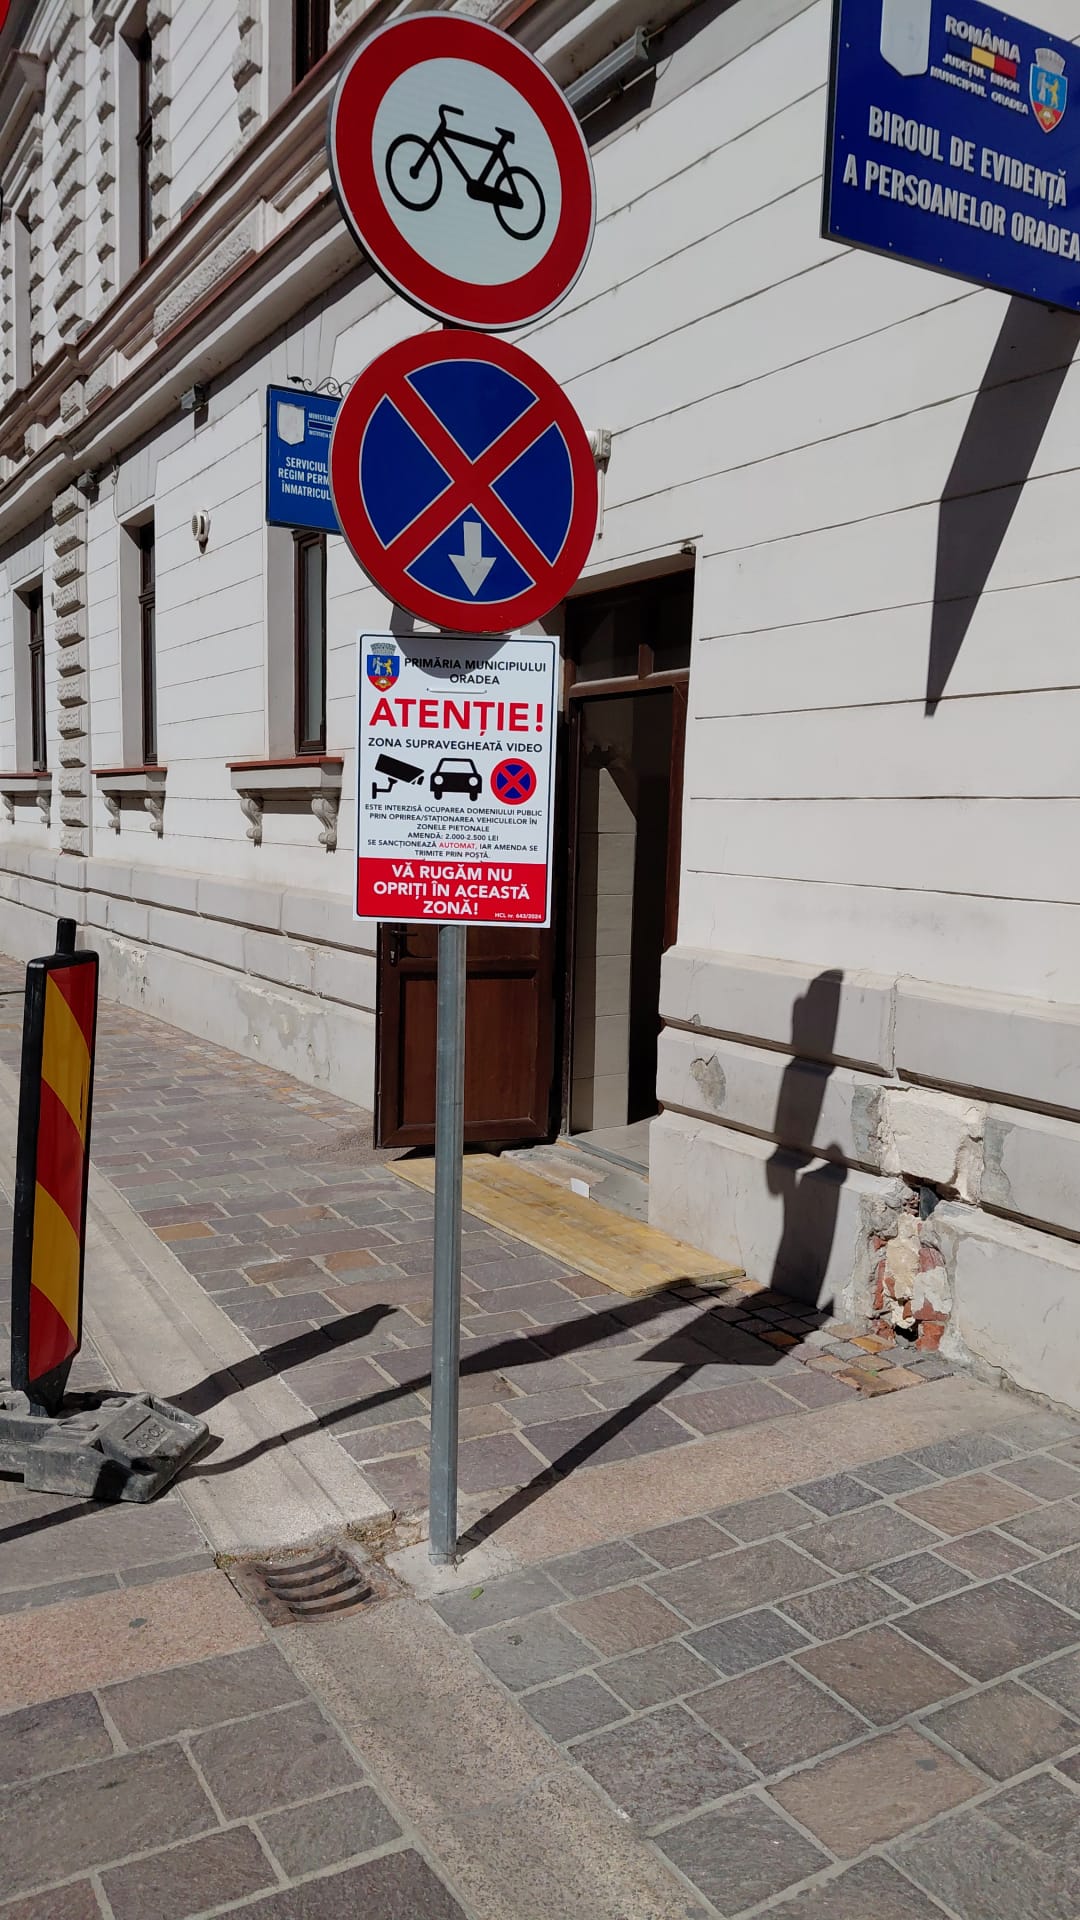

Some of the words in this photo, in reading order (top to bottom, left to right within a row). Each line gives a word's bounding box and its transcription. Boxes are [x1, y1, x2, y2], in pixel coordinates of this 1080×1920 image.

[945, 14, 1020, 63] ROMÂNIA
[942, 53, 986, 79] JUDEȚUL
[990, 72, 1020, 93] BIHOR
[930, 65, 987, 97] MUNICIPIUL
[991, 91, 1029, 114] ORADEA
[868, 105, 944, 161] BIROUL
[950, 135, 976, 173] DE
[981, 147, 1066, 209] EVIDENȚĂ
[843, 154, 858, 186] A
[864, 160, 1006, 236] PERSOANELOR
[1011, 212, 1080, 262] ORADEA
[286, 456, 328, 474] SERVICIUL
[278, 467, 305, 482] REGIM
[404, 657, 462, 670] PRIMĂRIA
[465, 659, 547, 673] MUNICIPIULUI
[450, 673, 500, 685] ORADEA
[369, 697, 544, 736] ATENȚIE!
[368, 737, 402, 748] ZONA
[405, 738, 503, 752] SUPRAVEGHEATĂ
[506, 742, 543, 753] VIDEO
[384, 804, 423, 812] INTERZISĂ
[424, 806, 465, 814] OCUPAREA
[467, 807, 515, 816] DOMENIULUI
[516, 809, 543, 817] PUBLIC
[388, 813, 475, 823] OPRIREA/STAȚIONAREA
[476, 817, 528, 825] VEHICULELOR
[529, 817, 538, 825] ÎN
[416, 823, 447, 831] ZONELE
[448, 824, 490, 832] PIETONALE
[378, 839, 437, 848] SANCȚIONEAZĂ
[438, 841, 478, 850] AUTOMAT,
[493, 843, 528, 851] AMENDA
[445, 833, 487, 841] 2.000-2.500
[415, 849, 445, 857] TRIMITE
[392, 862, 415, 878] VĂ
[419, 864, 482, 881] RUGĂM
[487, 868, 513, 882] NU
[373, 881, 427, 900] OPRIȚI
[431, 880, 450, 897] ÎN
[454, 884, 530, 900] ACEASTĂ
[422, 899, 479, 915] ZONĂ!
